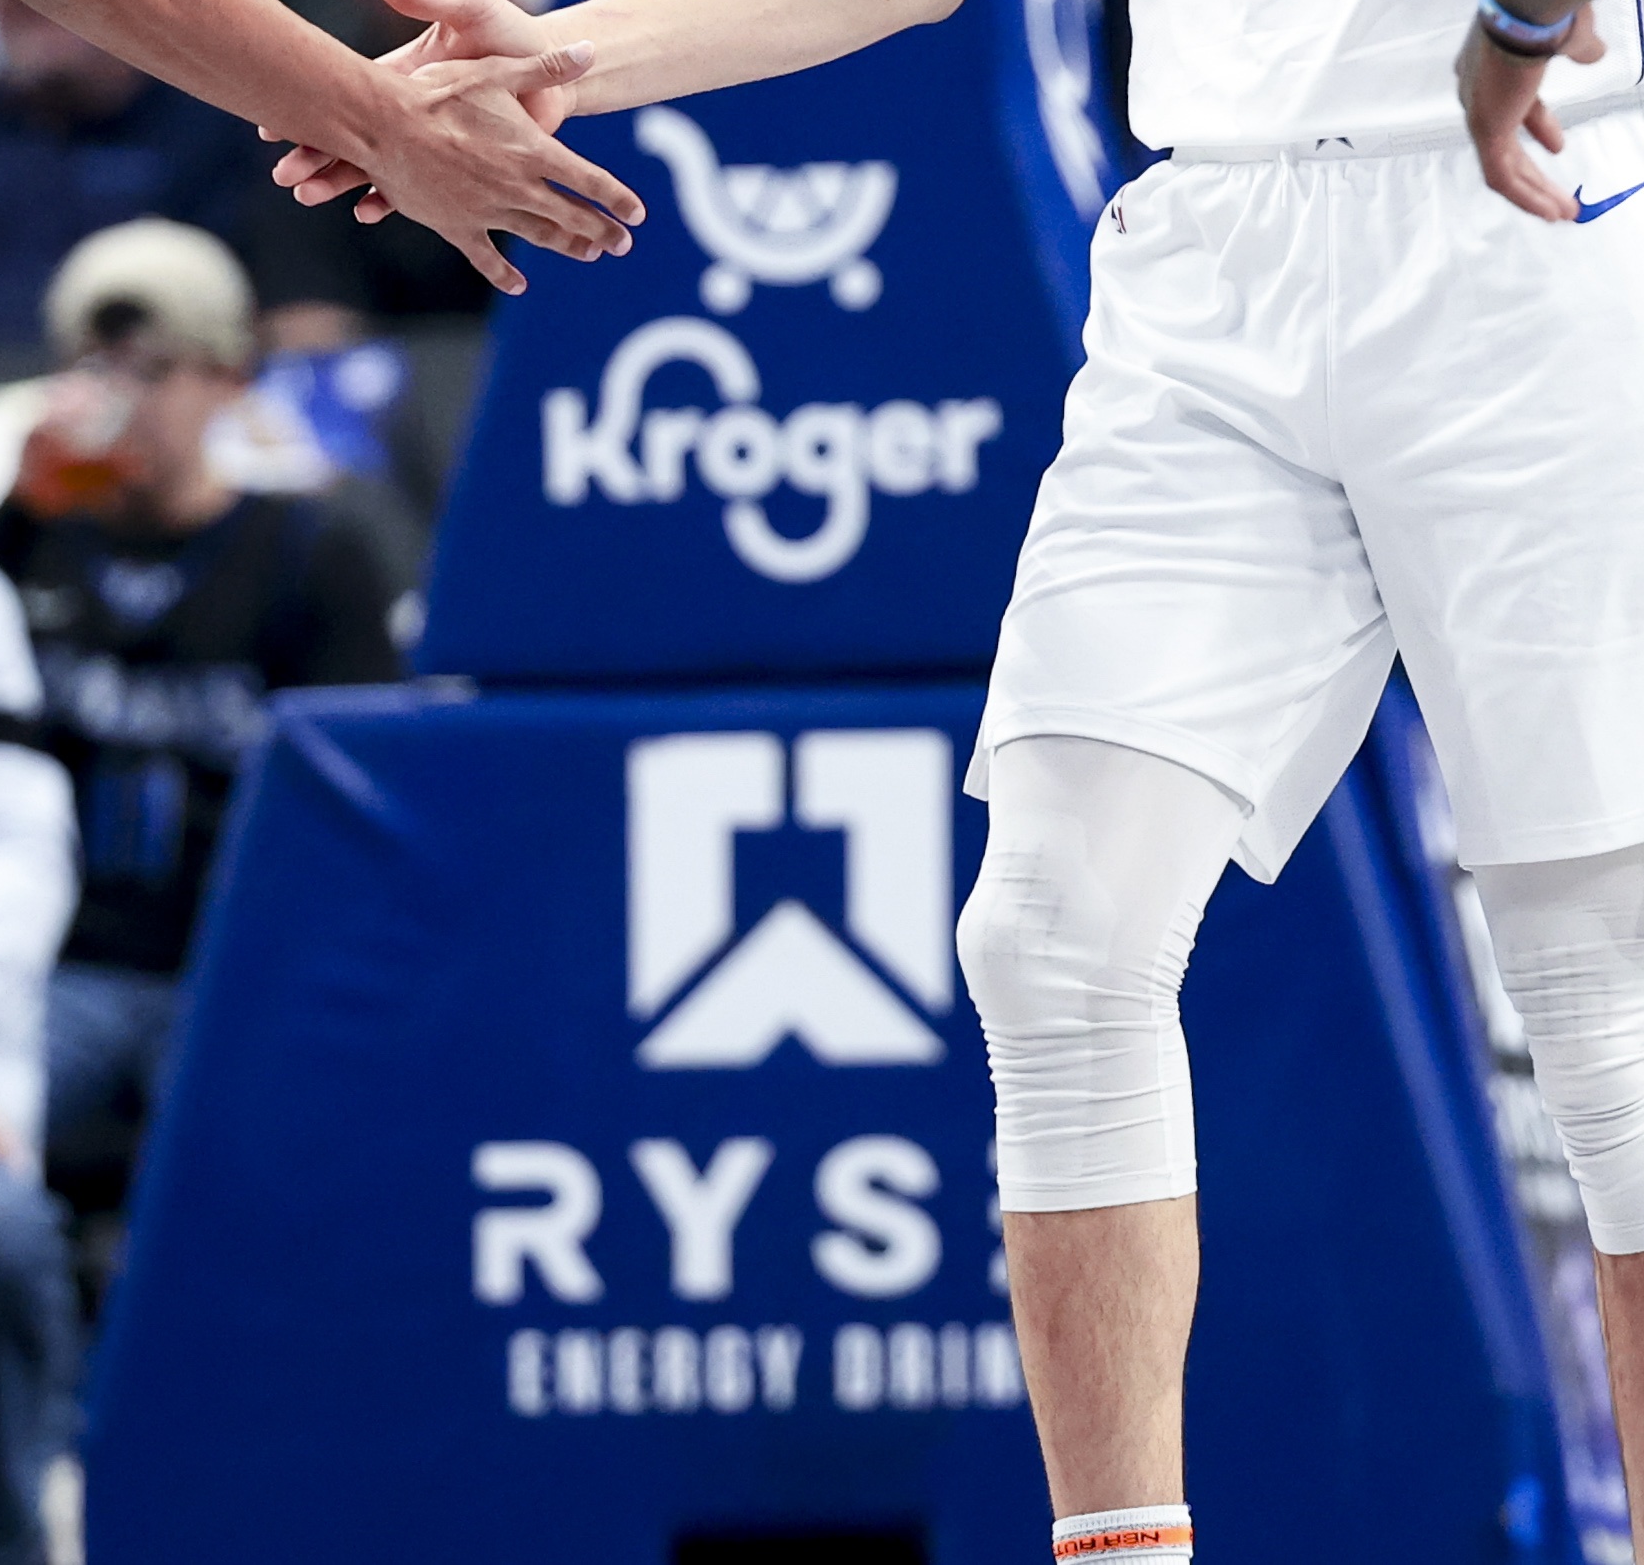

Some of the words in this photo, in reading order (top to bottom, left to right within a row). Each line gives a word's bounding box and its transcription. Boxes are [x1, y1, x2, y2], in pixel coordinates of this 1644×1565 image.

[542, 315, 1004, 584] Kroger
[470, 1133, 1010, 1304] RYS
[506, 1326, 803, 1416] ENERGY
[832, 1321, 1029, 1410] DRIN
